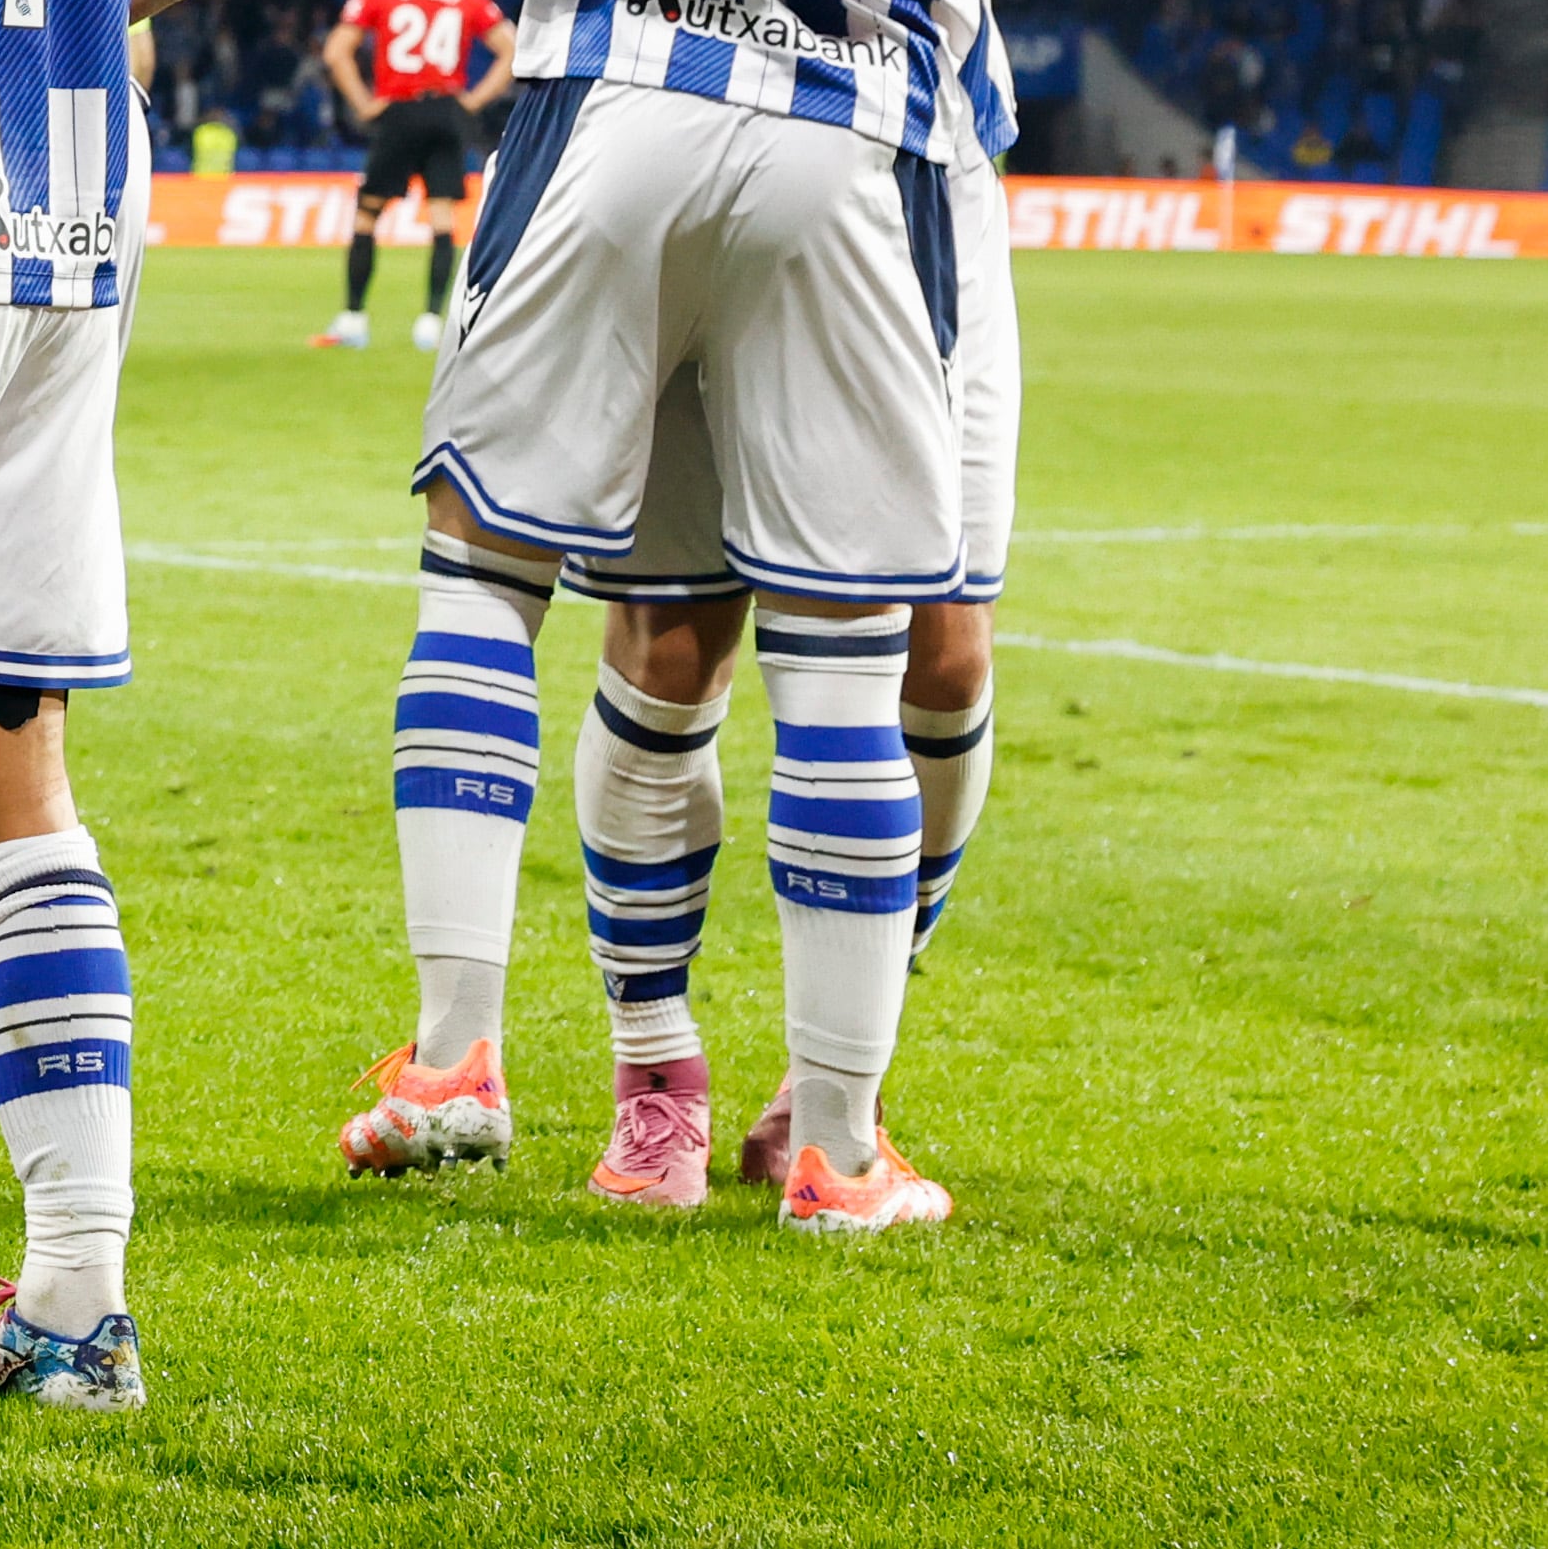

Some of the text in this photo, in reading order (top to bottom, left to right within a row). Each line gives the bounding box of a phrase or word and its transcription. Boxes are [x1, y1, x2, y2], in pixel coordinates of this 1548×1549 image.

[387, 3, 464, 77] 24
[1009, 188, 1220, 251] STIHL
[1273, 195, 1519, 259] STIHL
[455, 777, 515, 805] RS
[787, 871, 847, 899] RS
[37, 1050, 105, 1078] RS
